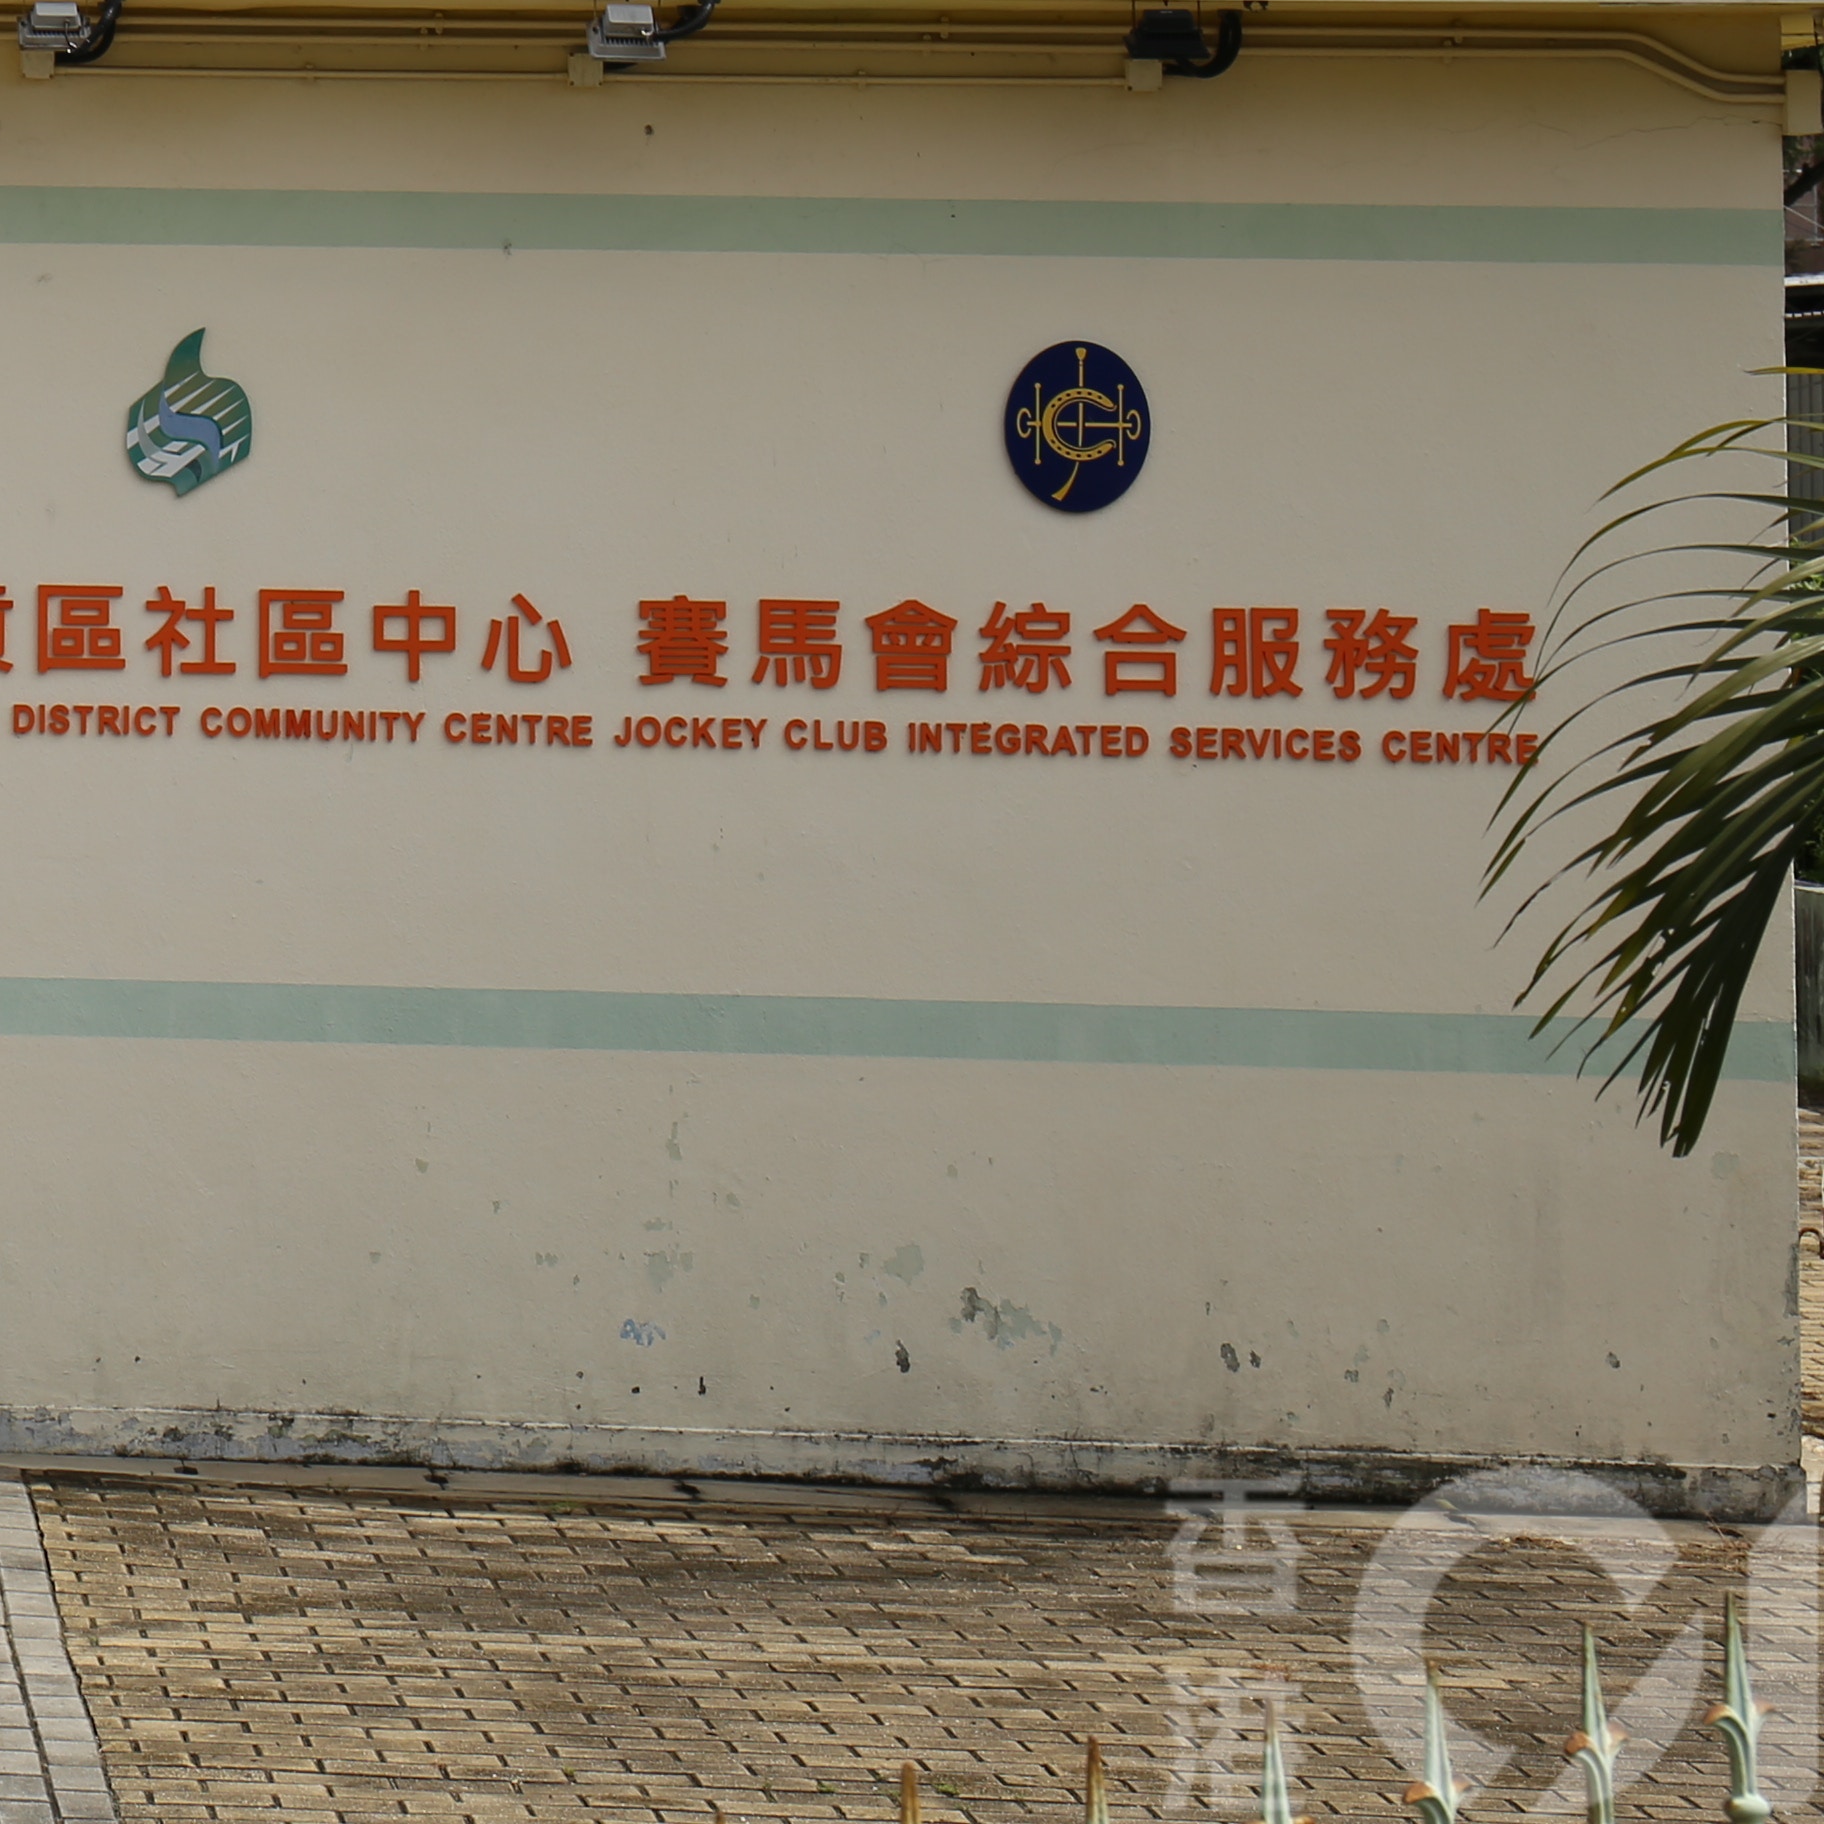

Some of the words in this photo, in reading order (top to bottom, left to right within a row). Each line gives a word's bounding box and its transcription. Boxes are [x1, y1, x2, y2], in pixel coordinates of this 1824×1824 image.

[636, 594, 1538, 703] 賽馬會綜合服務處
[11, 702, 182, 737] DISTRICT
[199, 705, 427, 742] COMMUNITY
[442, 711, 594, 747] CENTRE
[614, 715, 768, 750] JOCKEY
[782, 717, 889, 752] CLUB
[907, 721, 1151, 758] INTEGRATED
[1169, 725, 1363, 762] SERVICES
[1381, 729, 1541, 766] CENTRE
